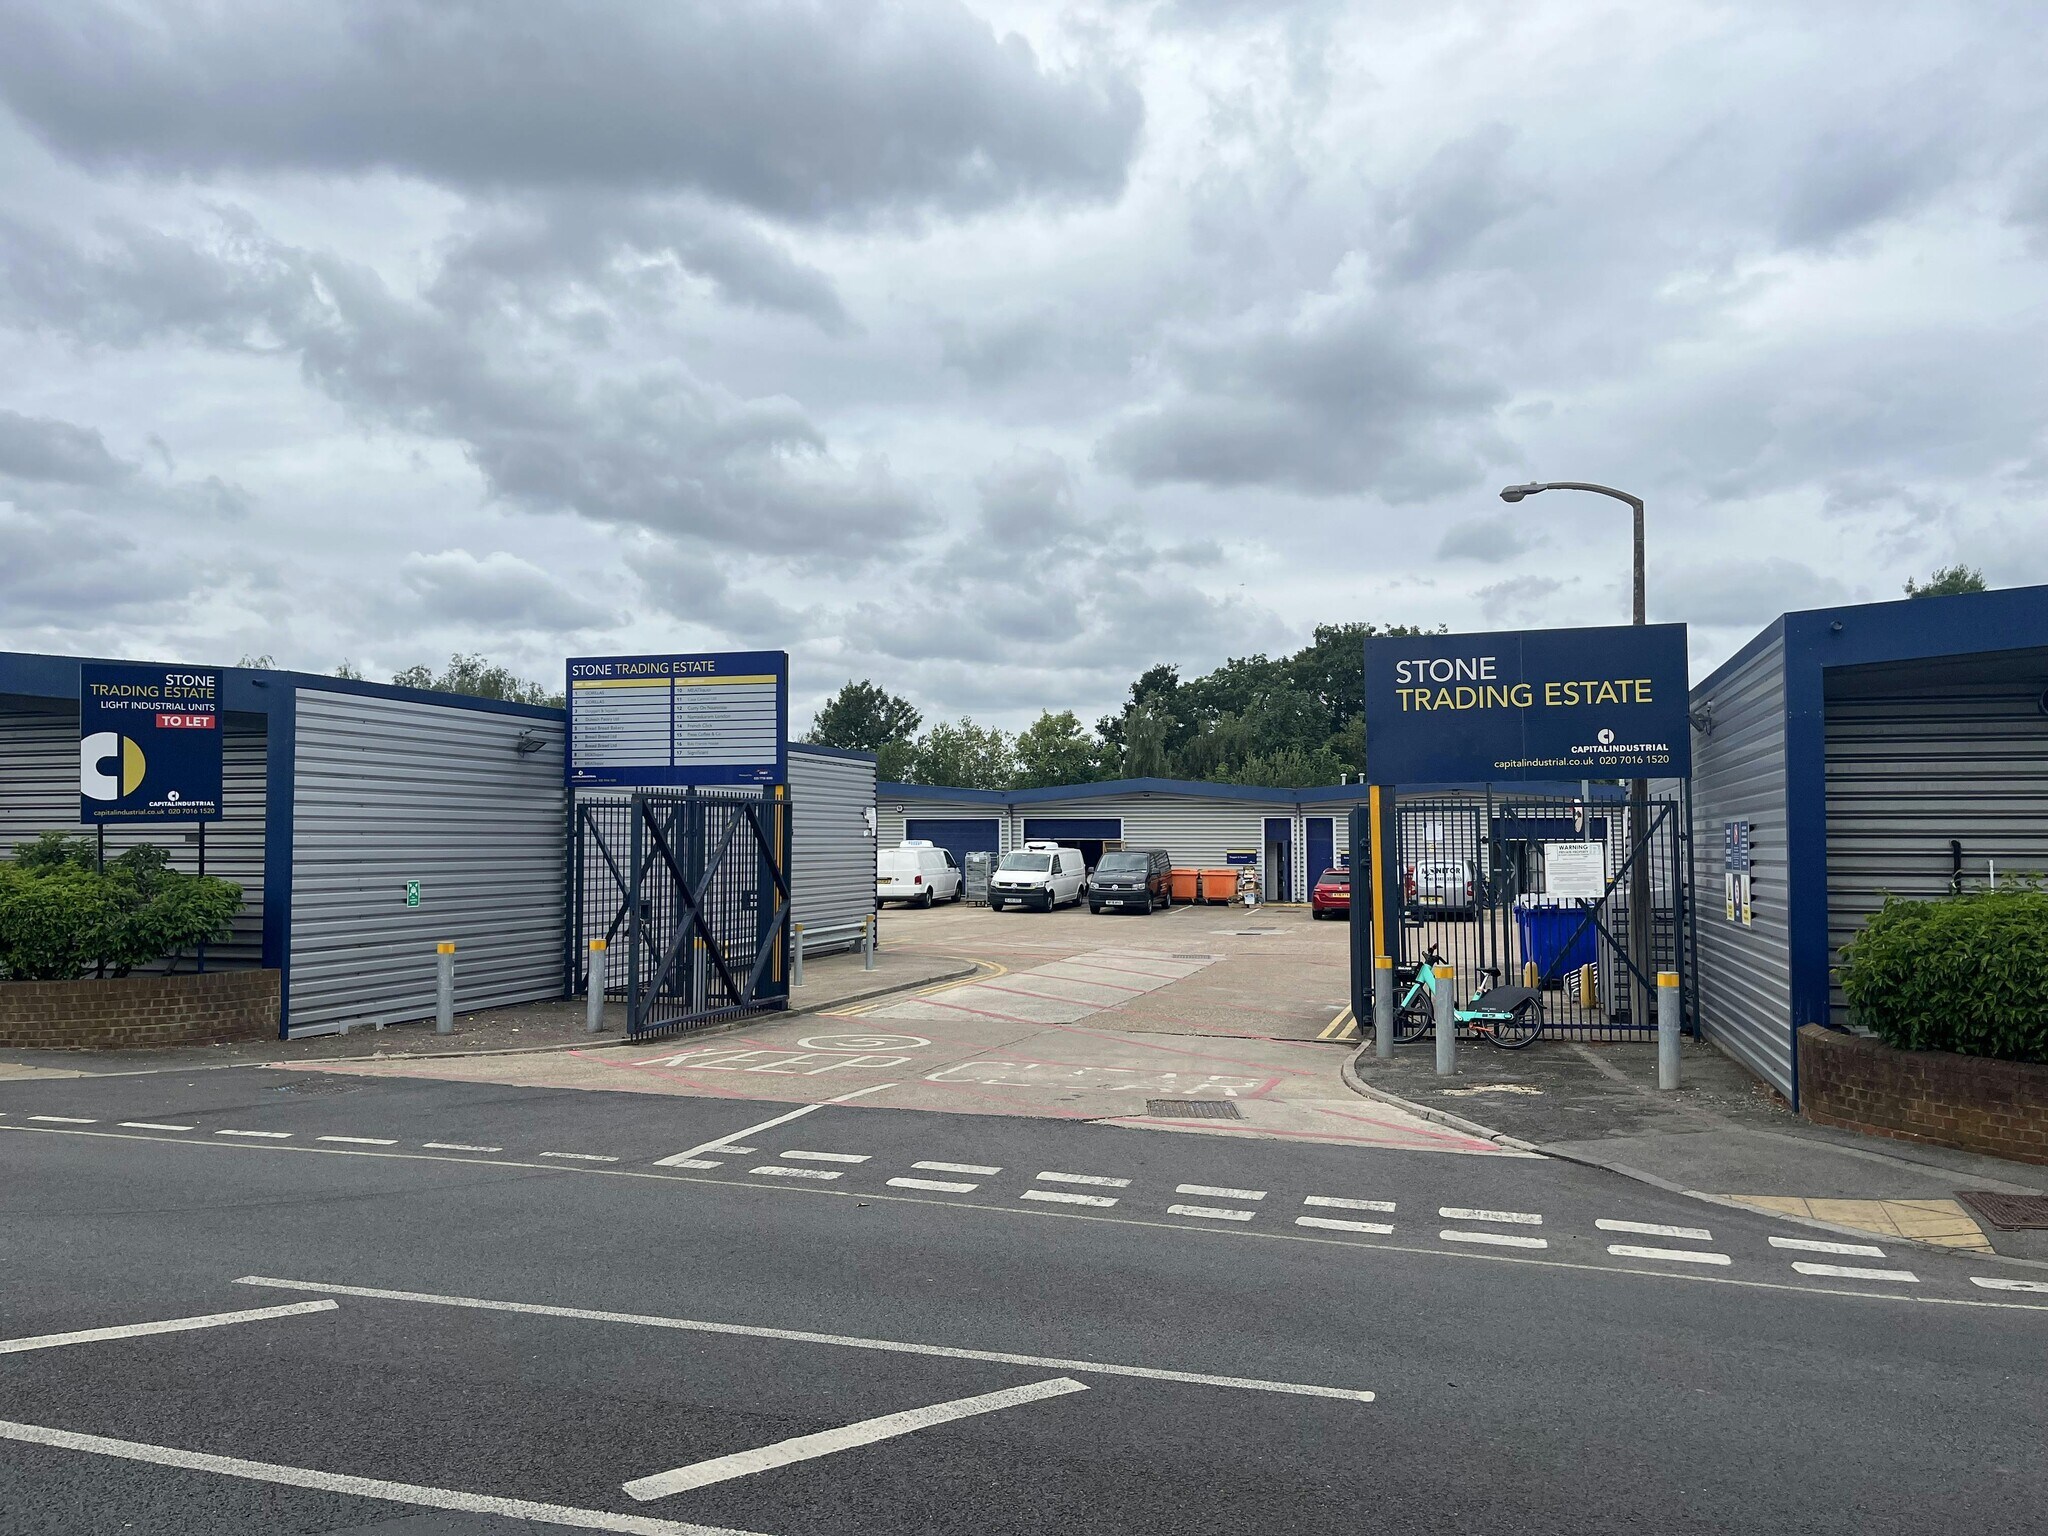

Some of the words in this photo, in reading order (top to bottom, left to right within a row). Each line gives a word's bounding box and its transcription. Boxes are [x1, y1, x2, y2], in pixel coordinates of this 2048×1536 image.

[572, 664, 612, 676] STONE
[614, 662, 669, 675] TRADING
[672, 660, 715, 673] ESTATE
[1395, 657, 1497, 684] STONE
[165, 674, 215, 687] STONE
[90, 684, 159, 697] TRADING
[164, 686, 215, 699] ESTATE
[1395, 683, 1533, 712] TRADING
[1545, 679, 1653, 706] ESTATE
[101, 701, 129, 709] LIGHT
[131, 702, 186, 711] INDUSTRIAL
[188, 703, 215, 711] UNITS
[162, 715, 182, 727] TO
[186, 716, 209, 727] LET
[1571, 743, 1669, 753] CAPITALINDUSTRIAL
[1494, 756, 1594, 770] capitalindustrial.co.uk
[1599, 756, 1617, 765] 020
[1620, 755, 1643, 764] 7016
[1646, 755, 1670, 764] 1520
[93, 808, 165, 817] capitalindustrial.co.uk
[631, 1048, 912, 1075] KEEP
